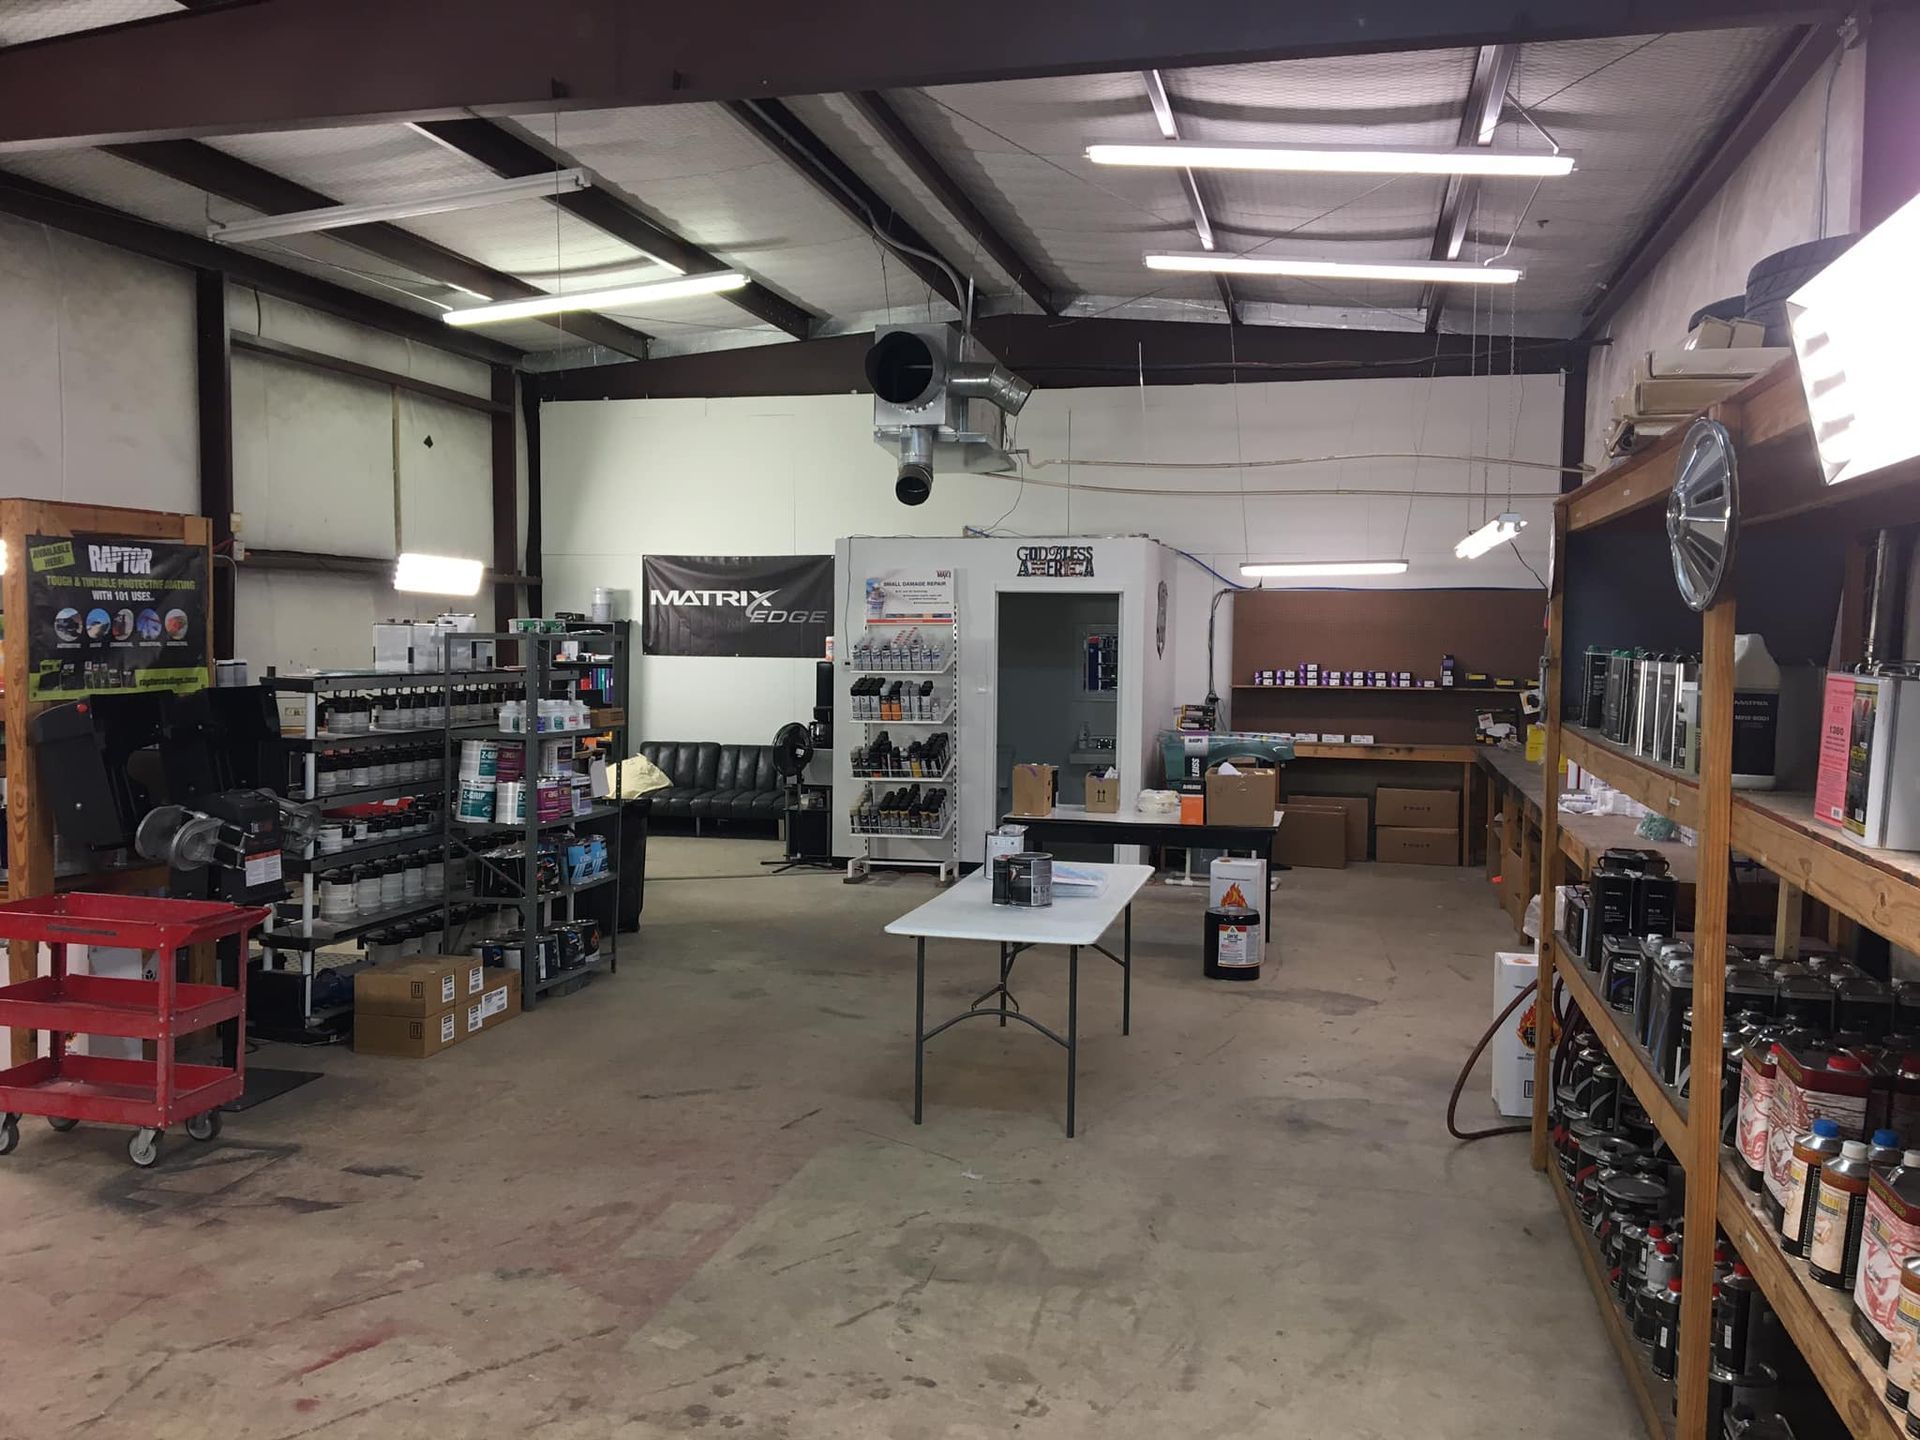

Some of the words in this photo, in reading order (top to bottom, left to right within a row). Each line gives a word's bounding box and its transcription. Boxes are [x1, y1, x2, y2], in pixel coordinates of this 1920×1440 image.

[88, 544, 153, 574] RAPTOR
[1016, 546, 1048, 561] GOD
[1016, 560, 1095, 577] AMERICA
[91, 590, 113, 601] WITH
[115, 591, 129, 601] 101
[650, 588, 782, 607] MATRIX
[750, 610, 828, 624] EDGE
